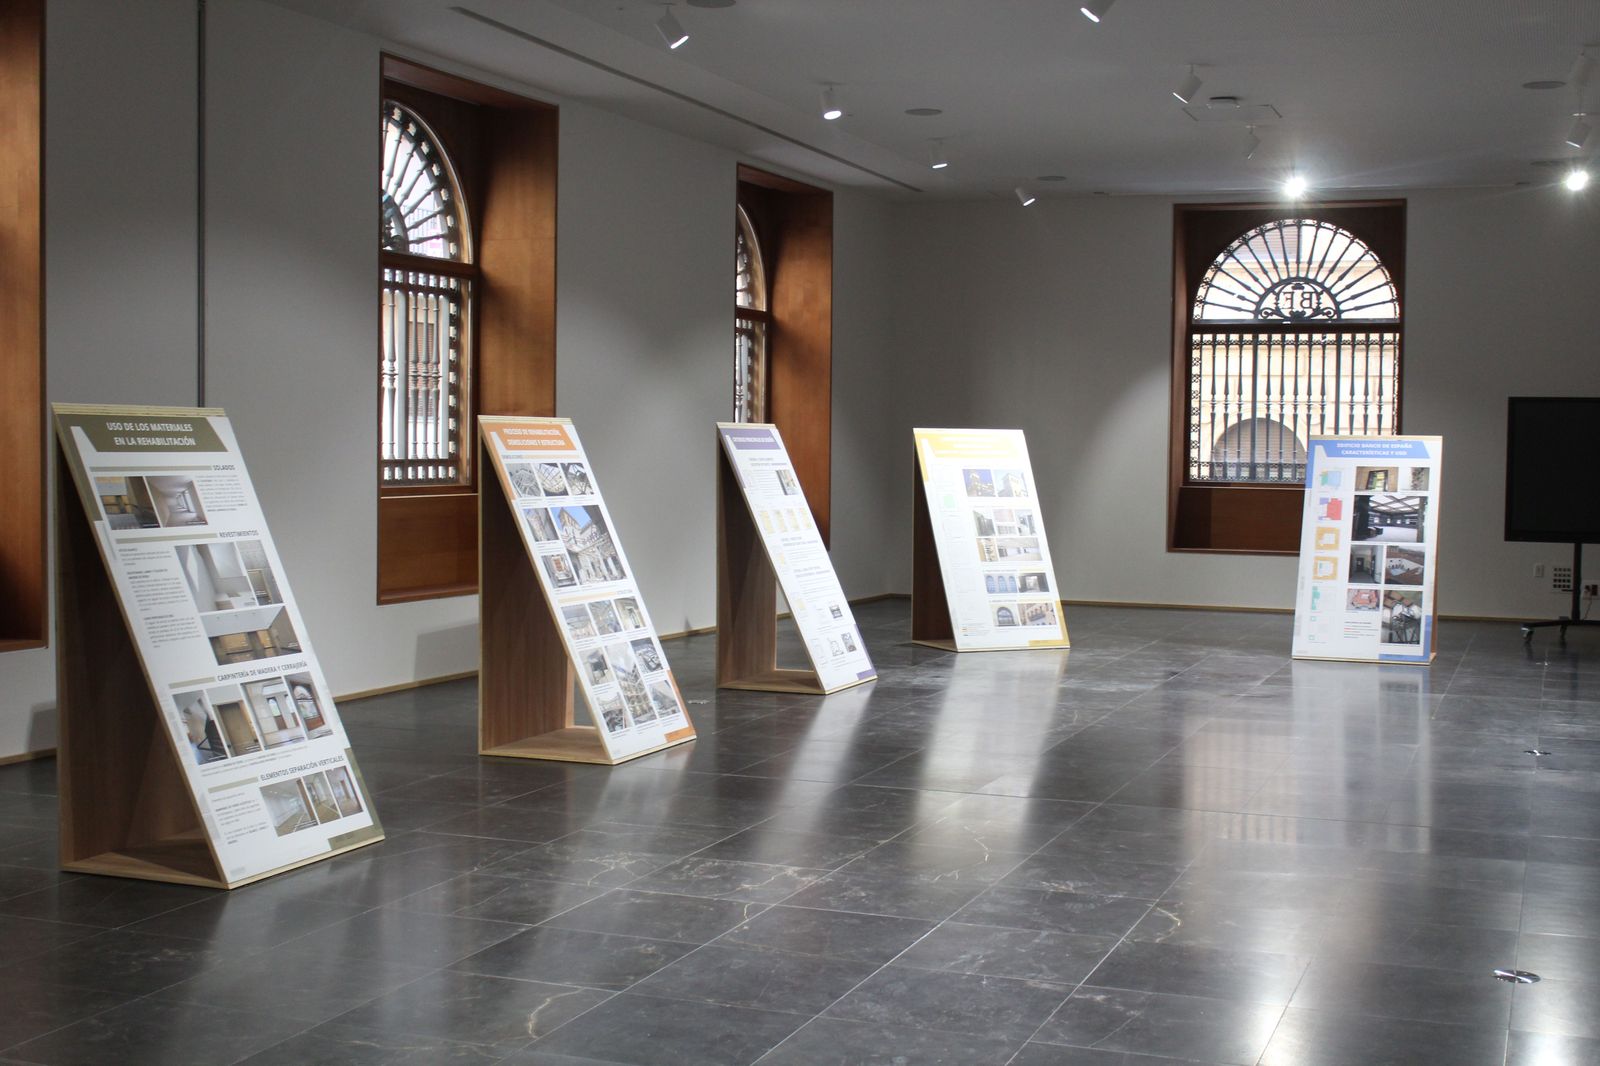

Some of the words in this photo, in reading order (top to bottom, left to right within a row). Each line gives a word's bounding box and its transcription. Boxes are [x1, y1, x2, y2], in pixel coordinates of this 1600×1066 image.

[106, 422, 122, 431] USO
[124, 423, 135, 431] DE
[136, 423, 149, 431] LOS
[150, 423, 193, 432] MATERIALES
[114, 437, 126, 445] EN
[126, 437, 137, 445] LA
[137, 436, 196, 446] REHABILITACIÓN
[219, 530, 259, 538] REVESTIMIENTOS
[217, 670, 249, 682] CARPINTERÍA
[250, 668, 257, 676] DE
[258, 666, 277, 675] MADERA
[281, 661, 308, 671] CERRAJERÍA
[260, 768, 289, 781] ELEMENTOS
[289, 761, 318, 775] SEPARACIÓN
[318, 755, 345, 767] VERTICALES
